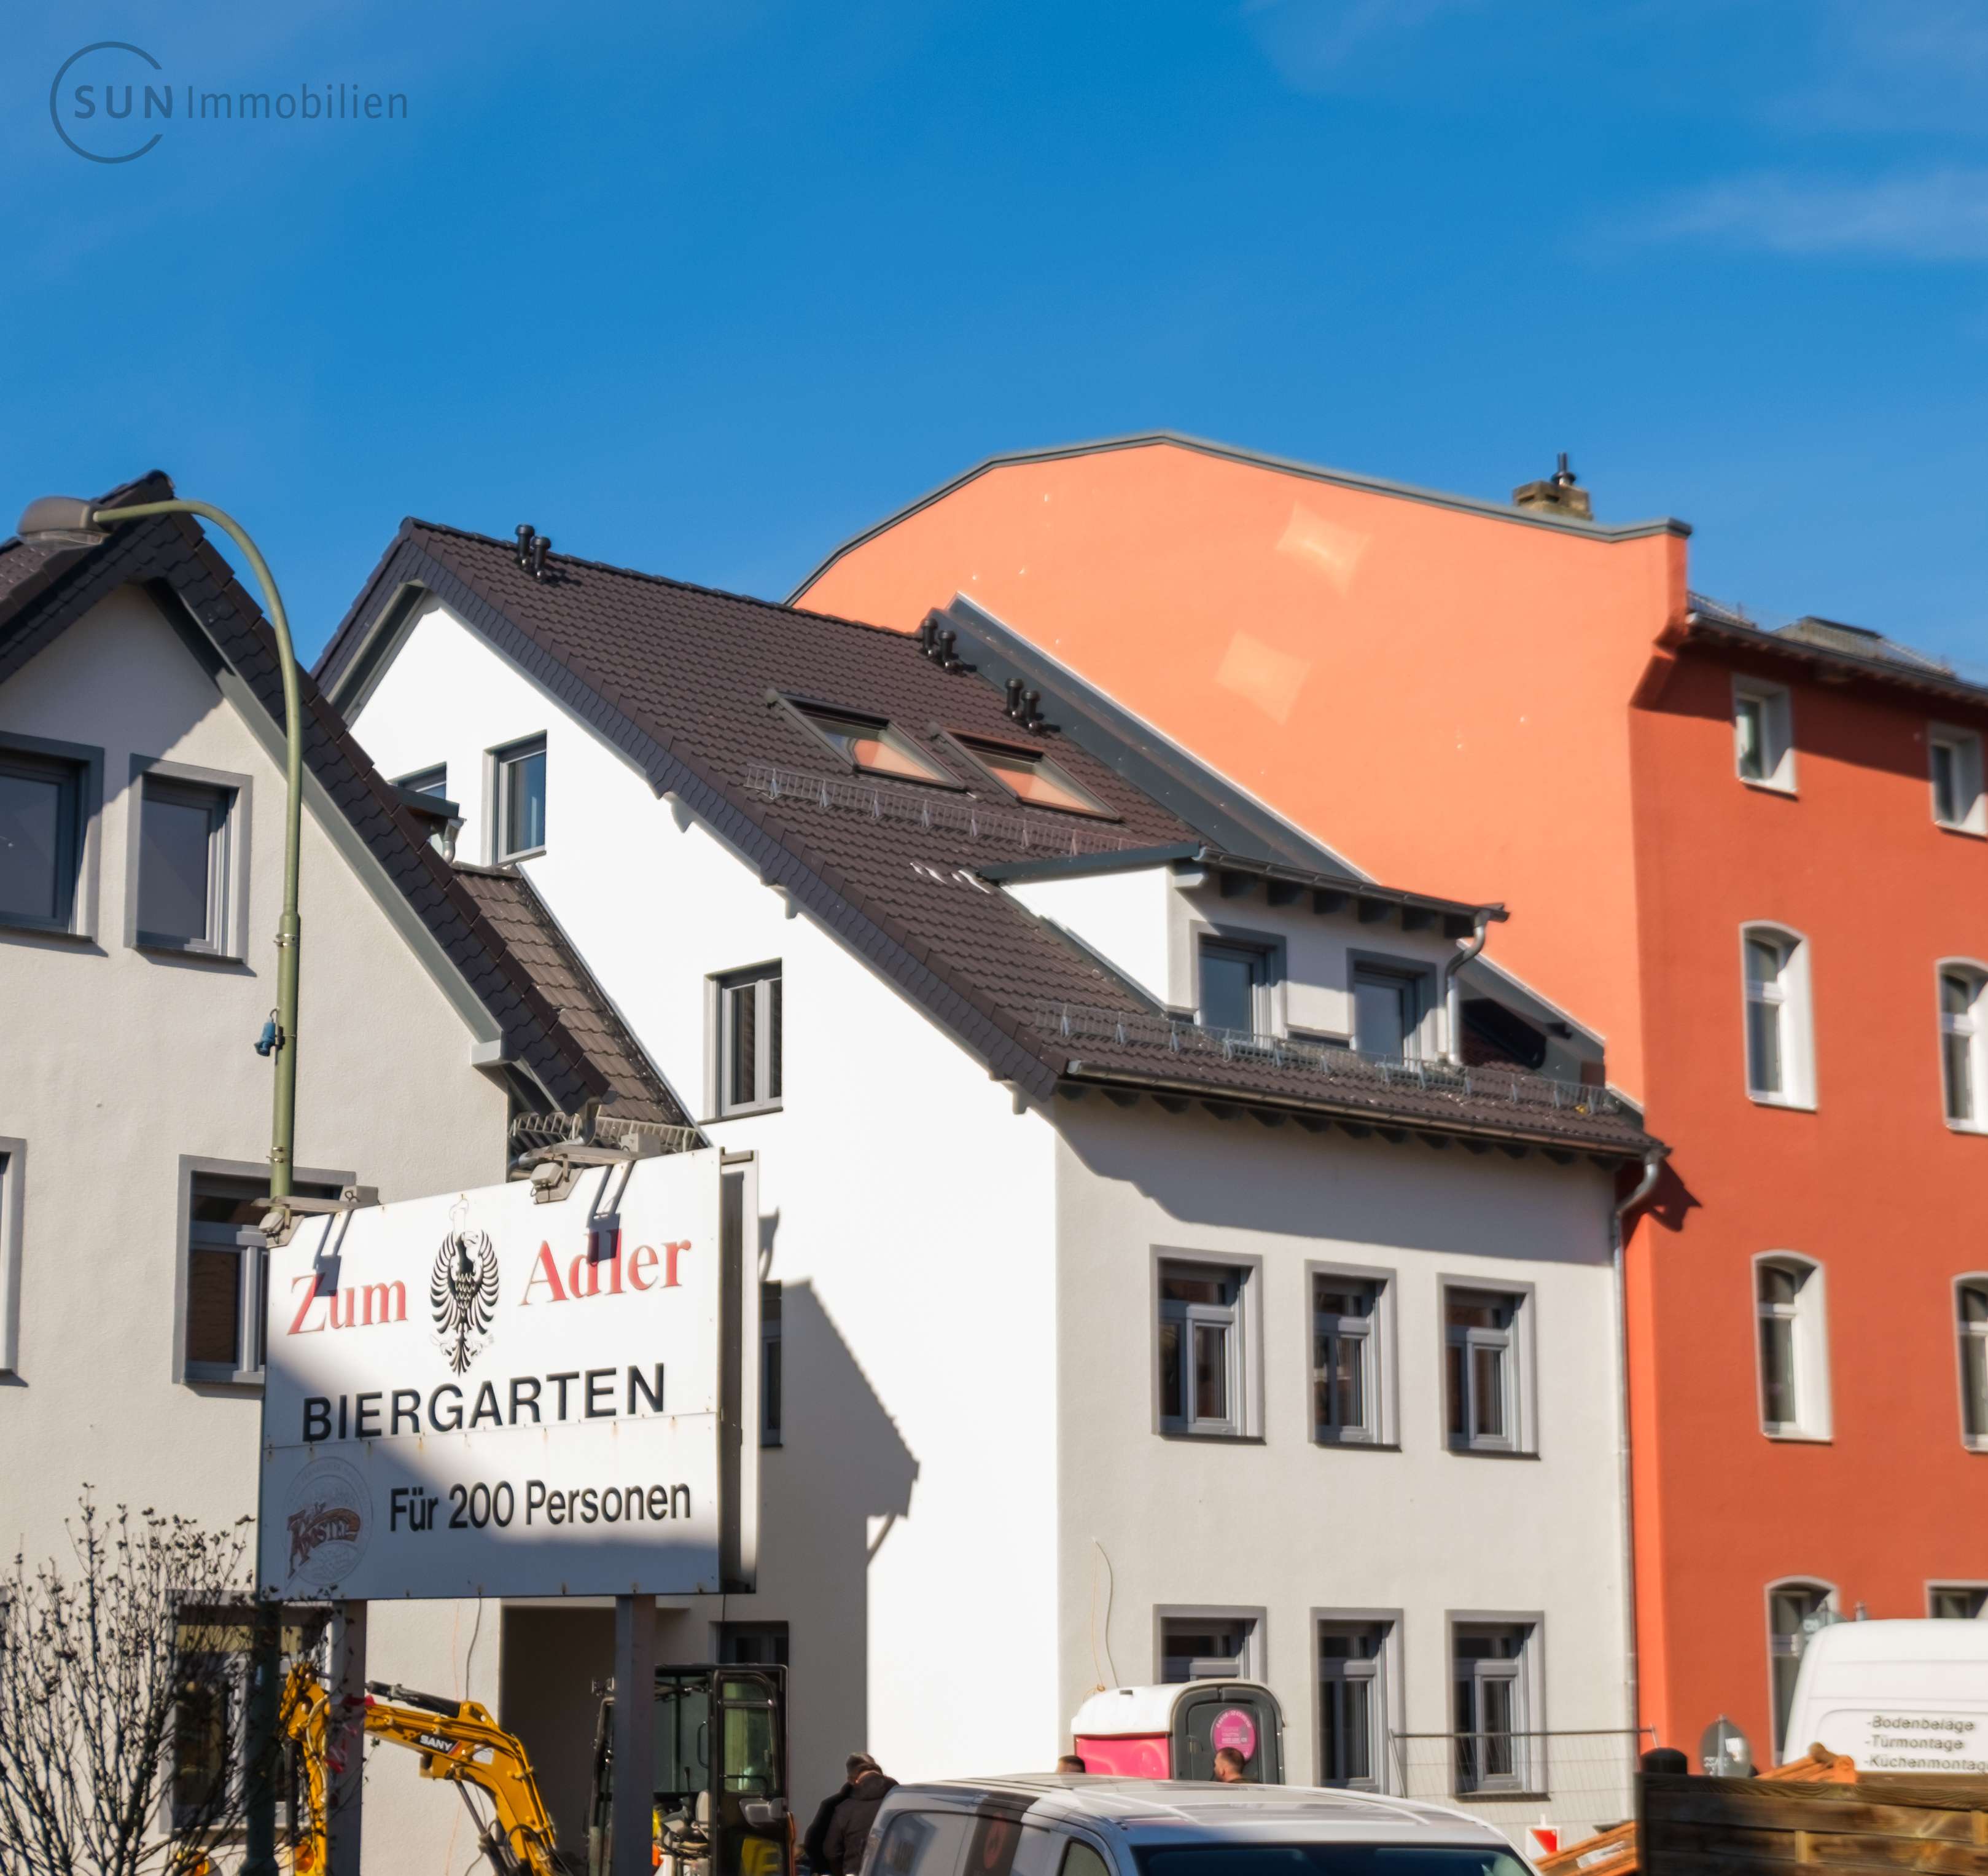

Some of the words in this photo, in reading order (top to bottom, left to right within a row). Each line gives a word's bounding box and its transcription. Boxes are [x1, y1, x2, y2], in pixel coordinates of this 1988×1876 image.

[287, 1272, 408, 1336] Zum
[518, 1228, 692, 1307] Adler
[302, 1362, 666, 1442] BIERGARTEN
[390, 1487, 439, 1533] Für
[448, 1480, 515, 1530] 200
[525, 1479, 692, 1526] Personen
[419, 1733, 453, 1751] SANY
[1864, 1754, 1988, 1774] -Küchenmontag
